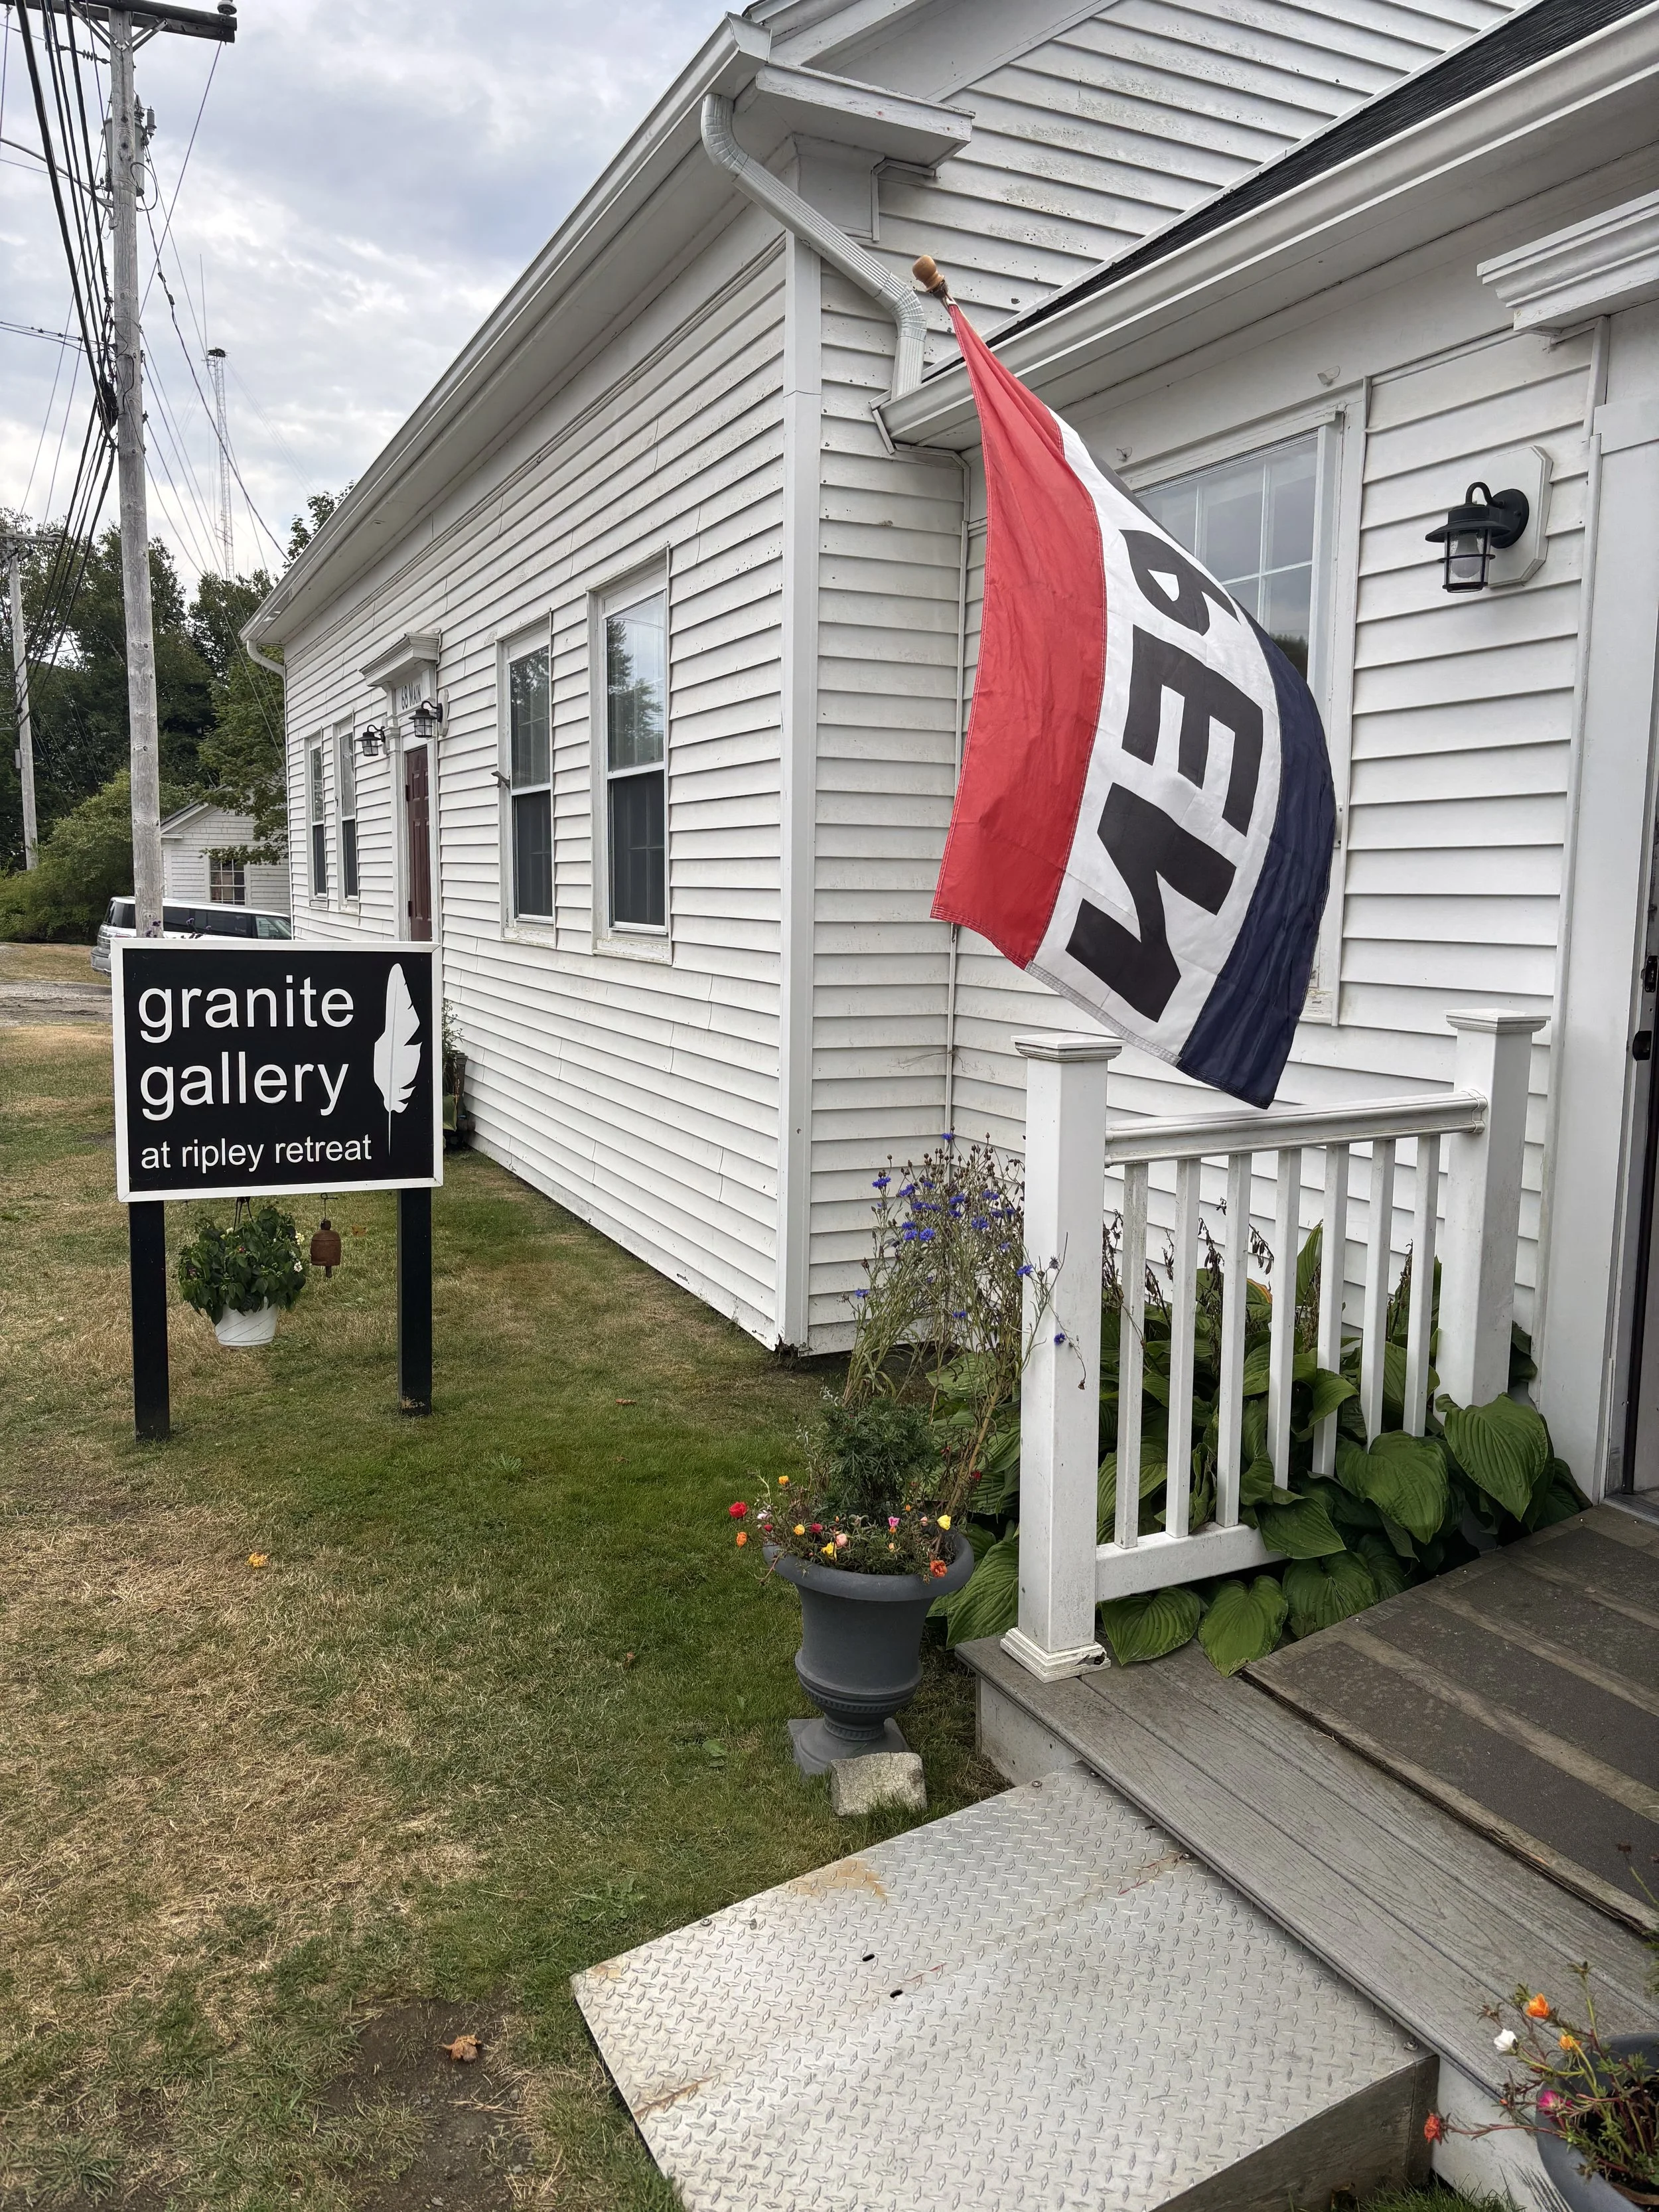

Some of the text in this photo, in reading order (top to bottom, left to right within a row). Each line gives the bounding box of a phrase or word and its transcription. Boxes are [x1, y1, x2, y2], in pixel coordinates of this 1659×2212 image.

[401, 685, 408, 710] 68
[138, 975, 354, 1043] granite
[140, 1051, 349, 1121] gallery
[141, 1134, 372, 1174] at ripley retreat
